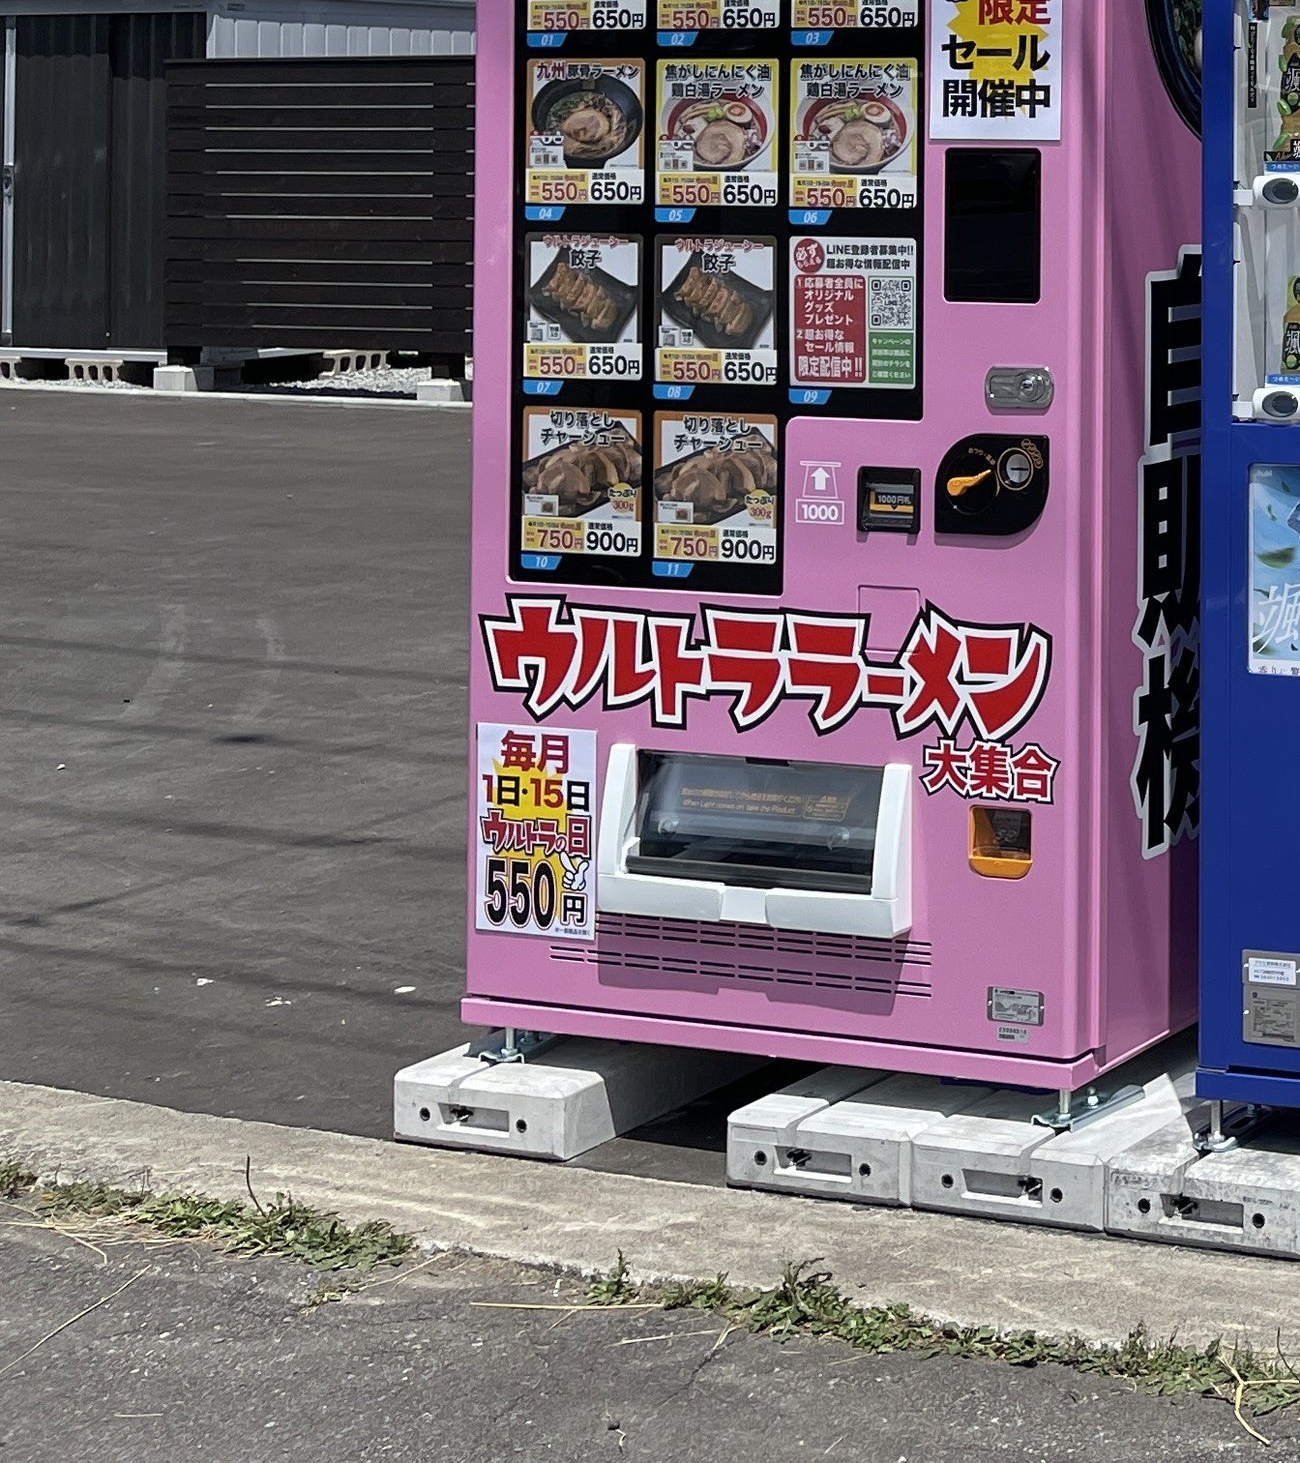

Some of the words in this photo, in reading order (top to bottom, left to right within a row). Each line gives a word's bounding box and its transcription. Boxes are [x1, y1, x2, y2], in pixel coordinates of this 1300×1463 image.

[592, 9, 644, 28] 650円
[723, 8, 775, 27] 650円
[860, 6, 915, 27] 650円
[541, 35, 554, 46] 01
[671, 33, 684, 45] 02
[805, 32, 819, 44] 03
[941, 34, 1051, 71] セール
[942, 78, 1051, 119] 開催中
[591, 181, 641, 201] 650円
[724, 184, 776, 204] 650円
[859, 188, 914, 207] 650円
[539, 208, 552, 220] 04
[668, 209, 682, 221] 05
[803, 212, 818, 224] 06
[570, 251, 602, 269] 餃子
[702, 254, 736, 272] 餃子
[804, 290, 854, 301] オリジナル
[804, 302, 835, 312] グッズ
[804, 314, 854, 325] プレゼント
[805, 341, 855, 353] セール情報
[588, 355, 640, 374] 650円
[724, 362, 776, 382] 650円
[536, 382, 550, 394] 07
[667, 386, 681, 398] 08
[803, 391, 818, 402] 09
[550, 410, 615, 427] 切り落とし
[683, 416, 751, 434] 切り落とし
[540, 428, 625, 446] チャーシュー
[674, 435, 762, 452] チャーシュー
[801, 506, 839, 522] 1000
[586, 532, 638, 553] 900円
[721, 539, 774, 561] 900円
[535, 556, 549, 568] 10
[666, 563, 680, 575] 11
[478, 592, 1053, 741] ウルトララーメン
[500, 729, 570, 774] 毎月
[919, 736, 1061, 805] 大集合
[482, 774, 590, 813] 1日・15日
[479, 808, 592, 859] ウルトラの日
[484, 856, 588, 930] 550円
